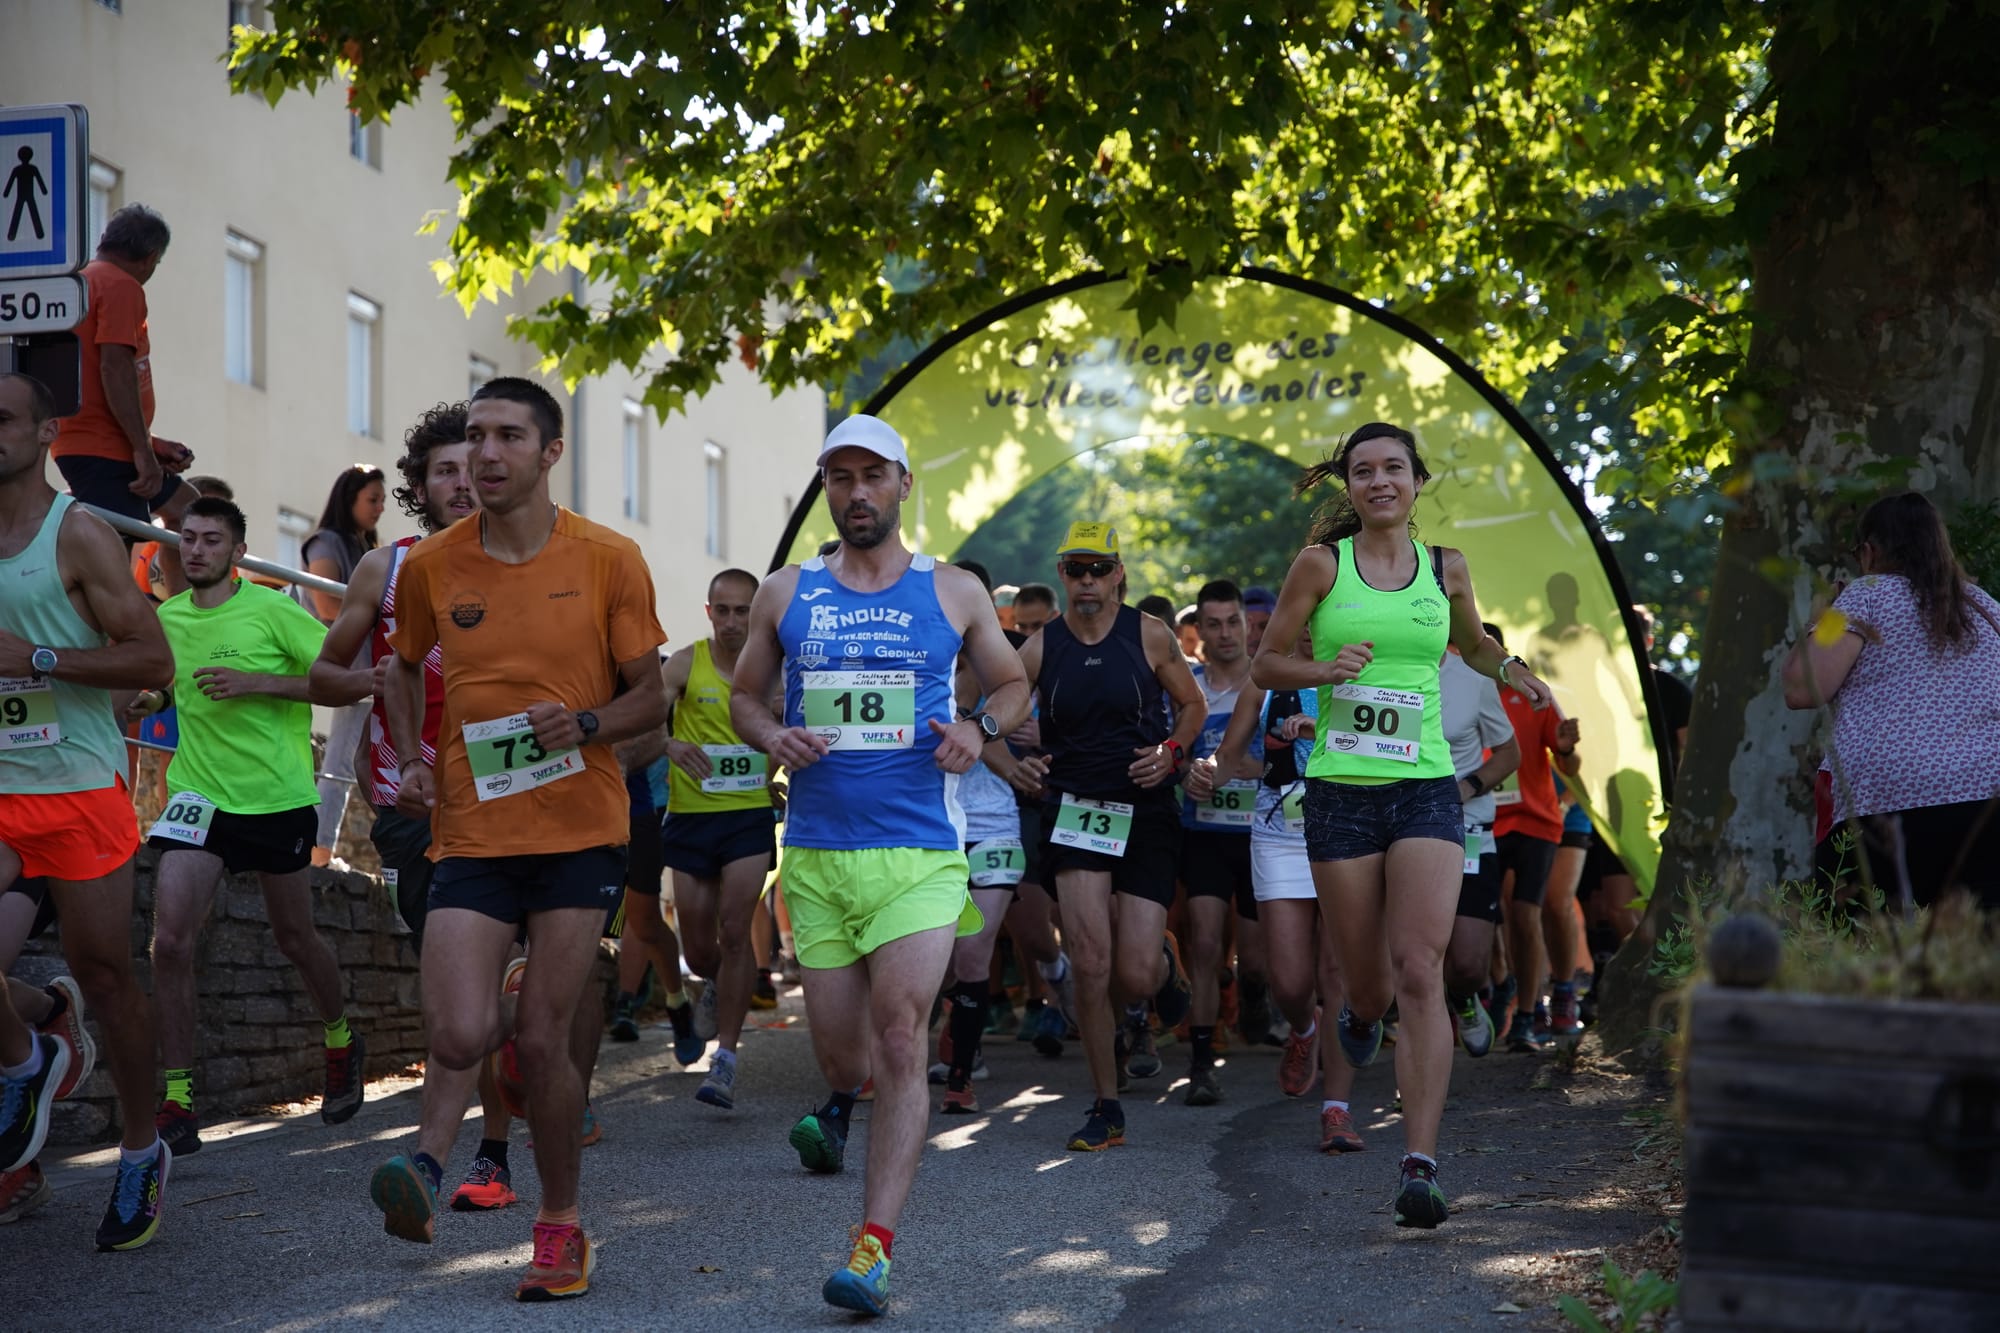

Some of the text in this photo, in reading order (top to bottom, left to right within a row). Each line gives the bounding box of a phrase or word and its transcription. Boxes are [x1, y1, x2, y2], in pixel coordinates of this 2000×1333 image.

[0, 292, 66, 322] 50 m
[1011, 331, 1340, 377] Challenge des
[1172, 371, 1366, 405] cévenoles
[0, 697, 28, 725] 9
[833, 691, 885, 723] 18
[1353, 704, 1400, 736] 90
[9, 731, 40, 741] TUFF'S
[1375, 742, 1404, 752] TUFF'S
[492, 732, 547, 769] 73
[530, 763, 563, 779] TUFF'S
[720, 757, 751, 776] 89
[1211, 790, 1241, 809] 66
[1078, 811, 1111, 835] 13
[986, 850, 1013, 869] 57
